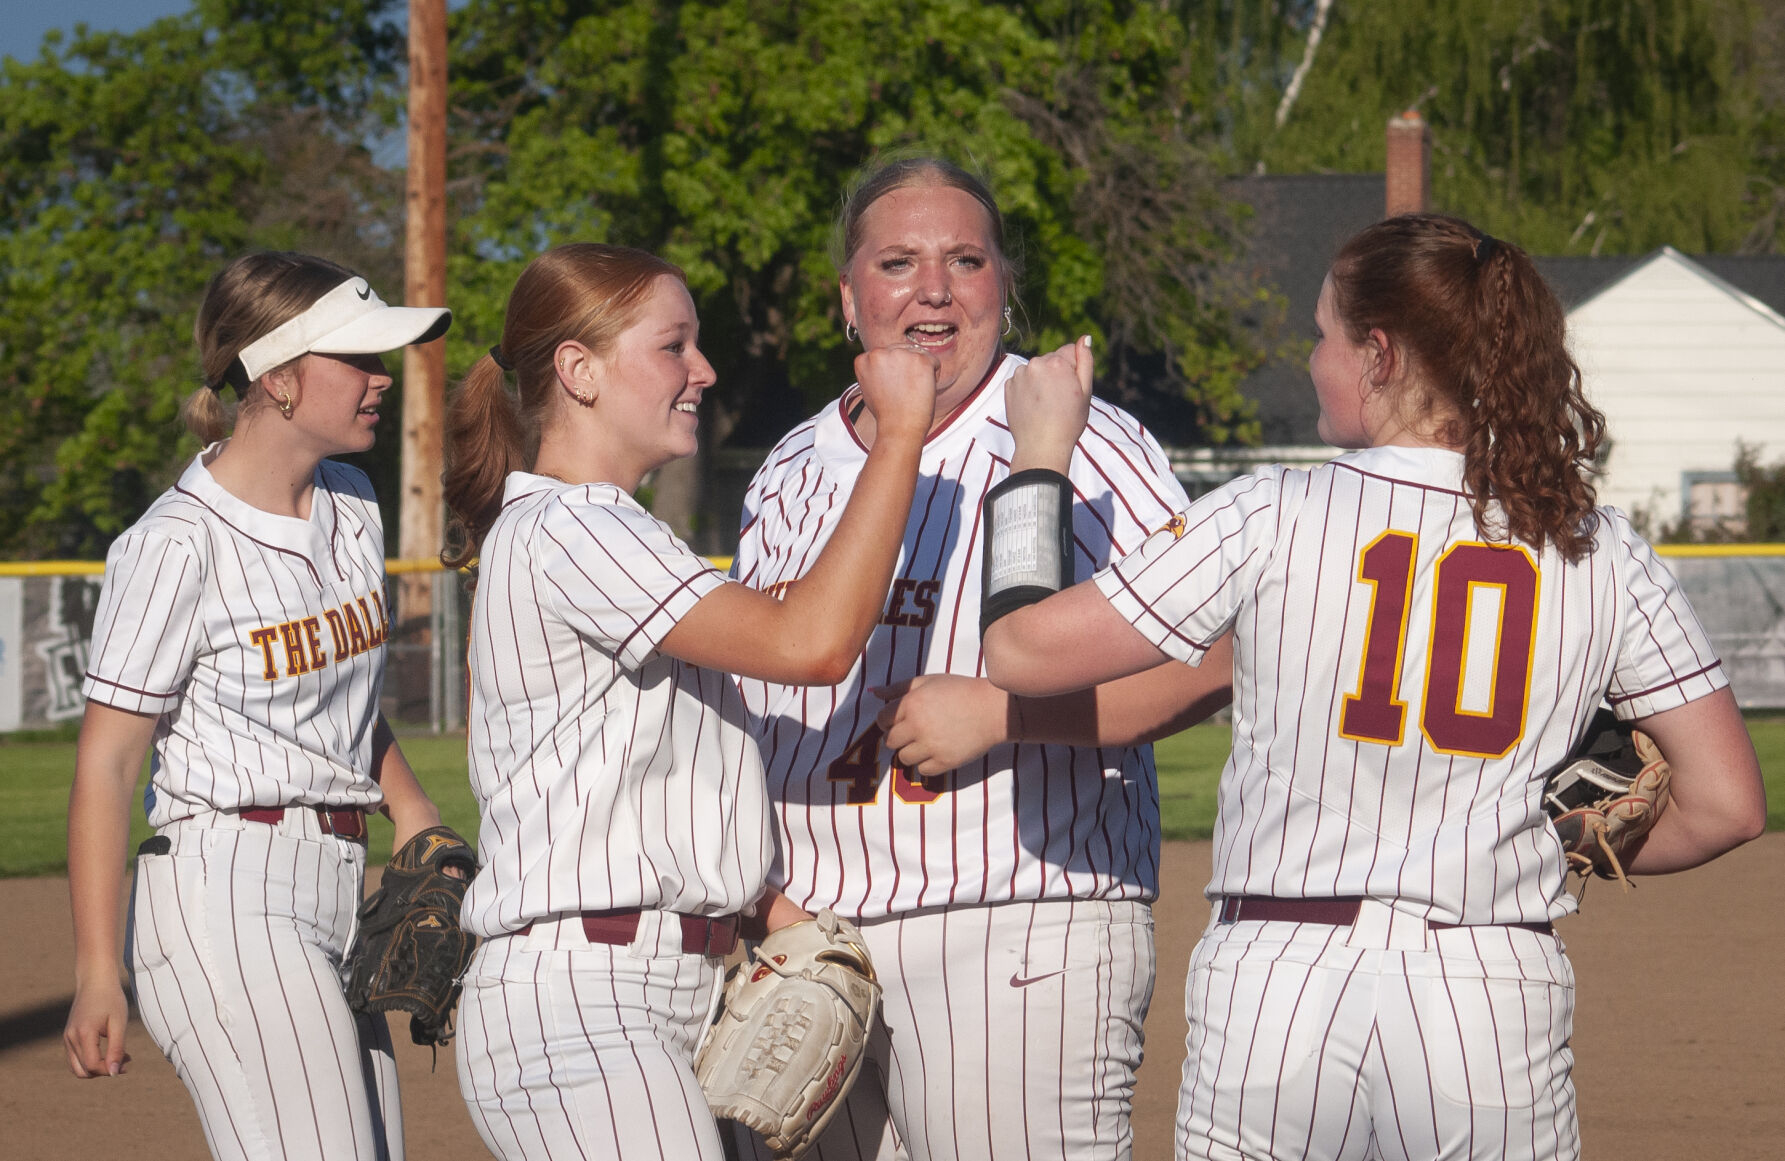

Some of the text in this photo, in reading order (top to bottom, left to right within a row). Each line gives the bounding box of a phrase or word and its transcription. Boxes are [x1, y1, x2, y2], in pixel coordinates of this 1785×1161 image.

[249, 582, 390, 681] THE DALL
[878, 578, 942, 629] ES
[1338, 528, 1542, 760] 10
